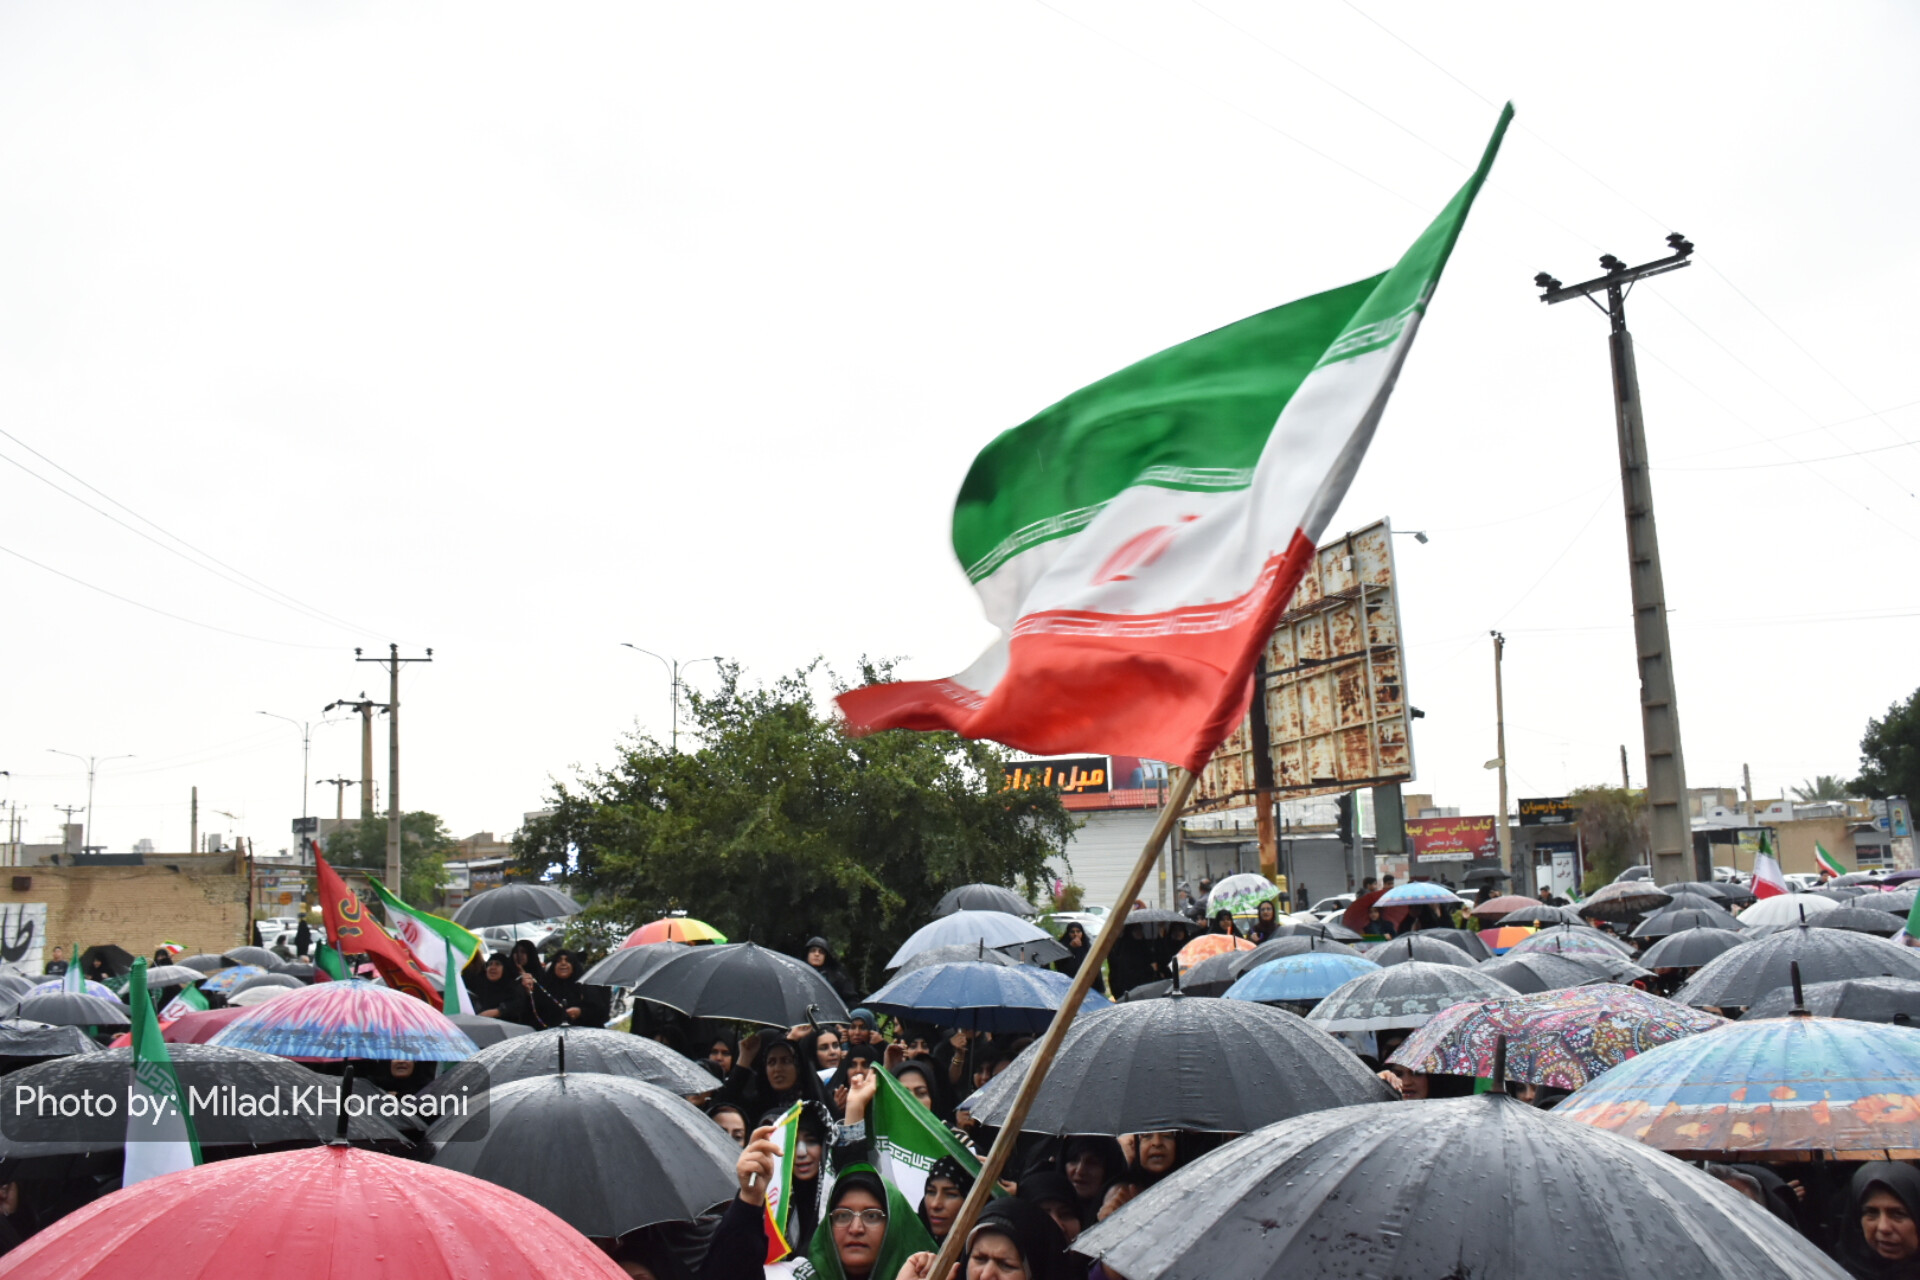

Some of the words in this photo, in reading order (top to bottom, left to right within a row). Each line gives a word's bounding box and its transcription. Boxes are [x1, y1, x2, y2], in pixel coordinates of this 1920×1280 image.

[1058, 765, 1105, 793] مبل
[1521, 801, 1558, 816] پارسیان
[1425, 822, 1446, 837] سنتی
[1448, 819, 1471, 836] شامی
[1472, 818, 1492, 833] کباب
